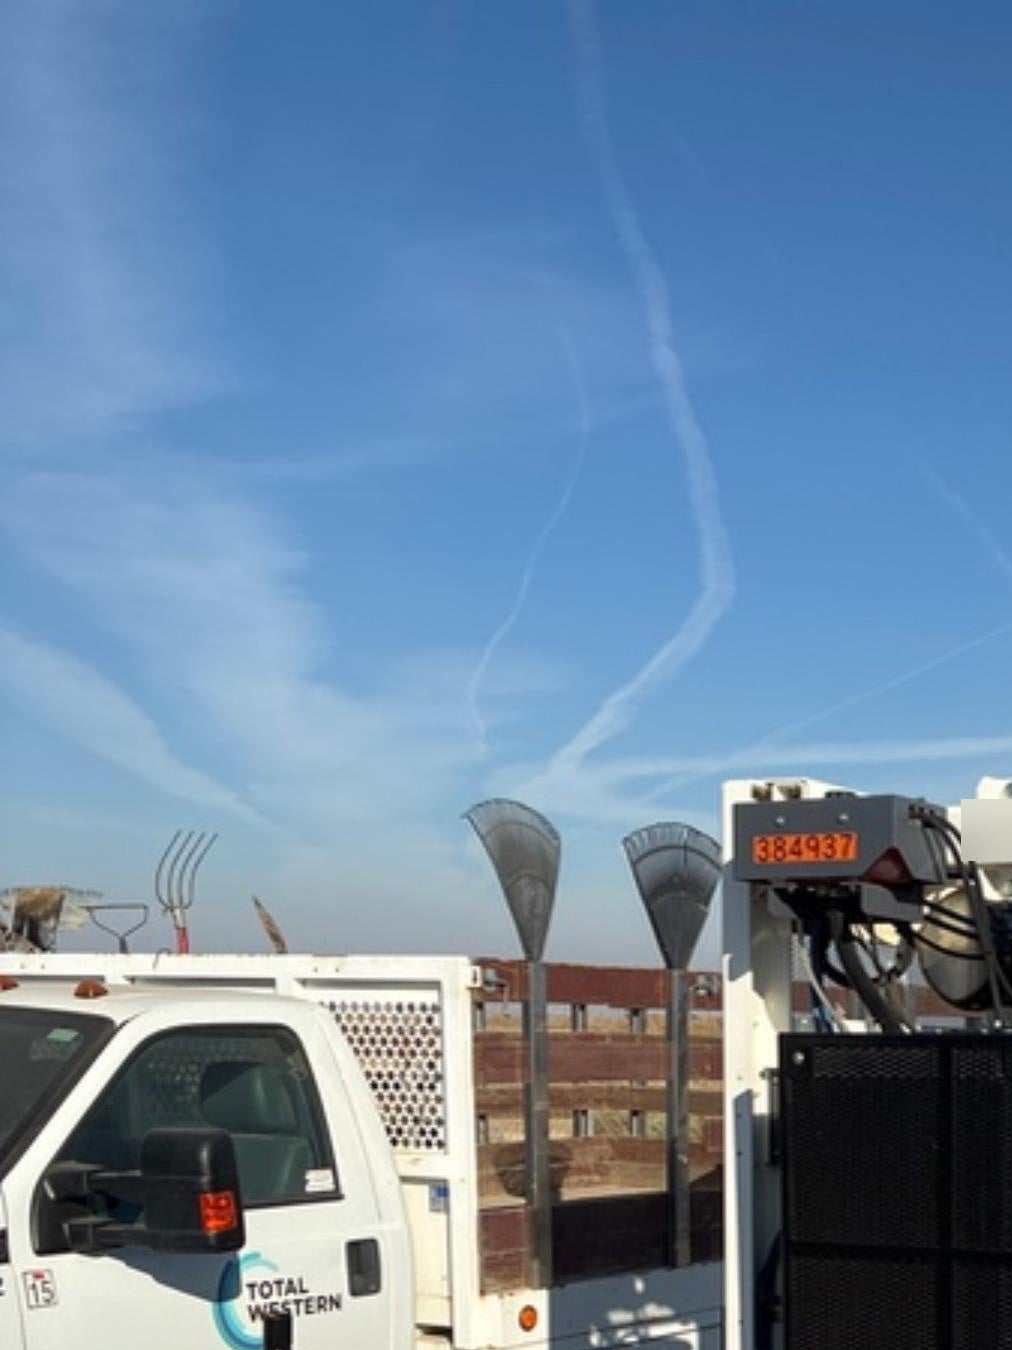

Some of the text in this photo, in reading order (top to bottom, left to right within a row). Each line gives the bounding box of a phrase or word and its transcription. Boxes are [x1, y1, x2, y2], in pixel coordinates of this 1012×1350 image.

[756, 833, 853, 862] 384937
[246, 1277, 309, 1300] TOTAL
[247, 1293, 342, 1322] WESTERN
